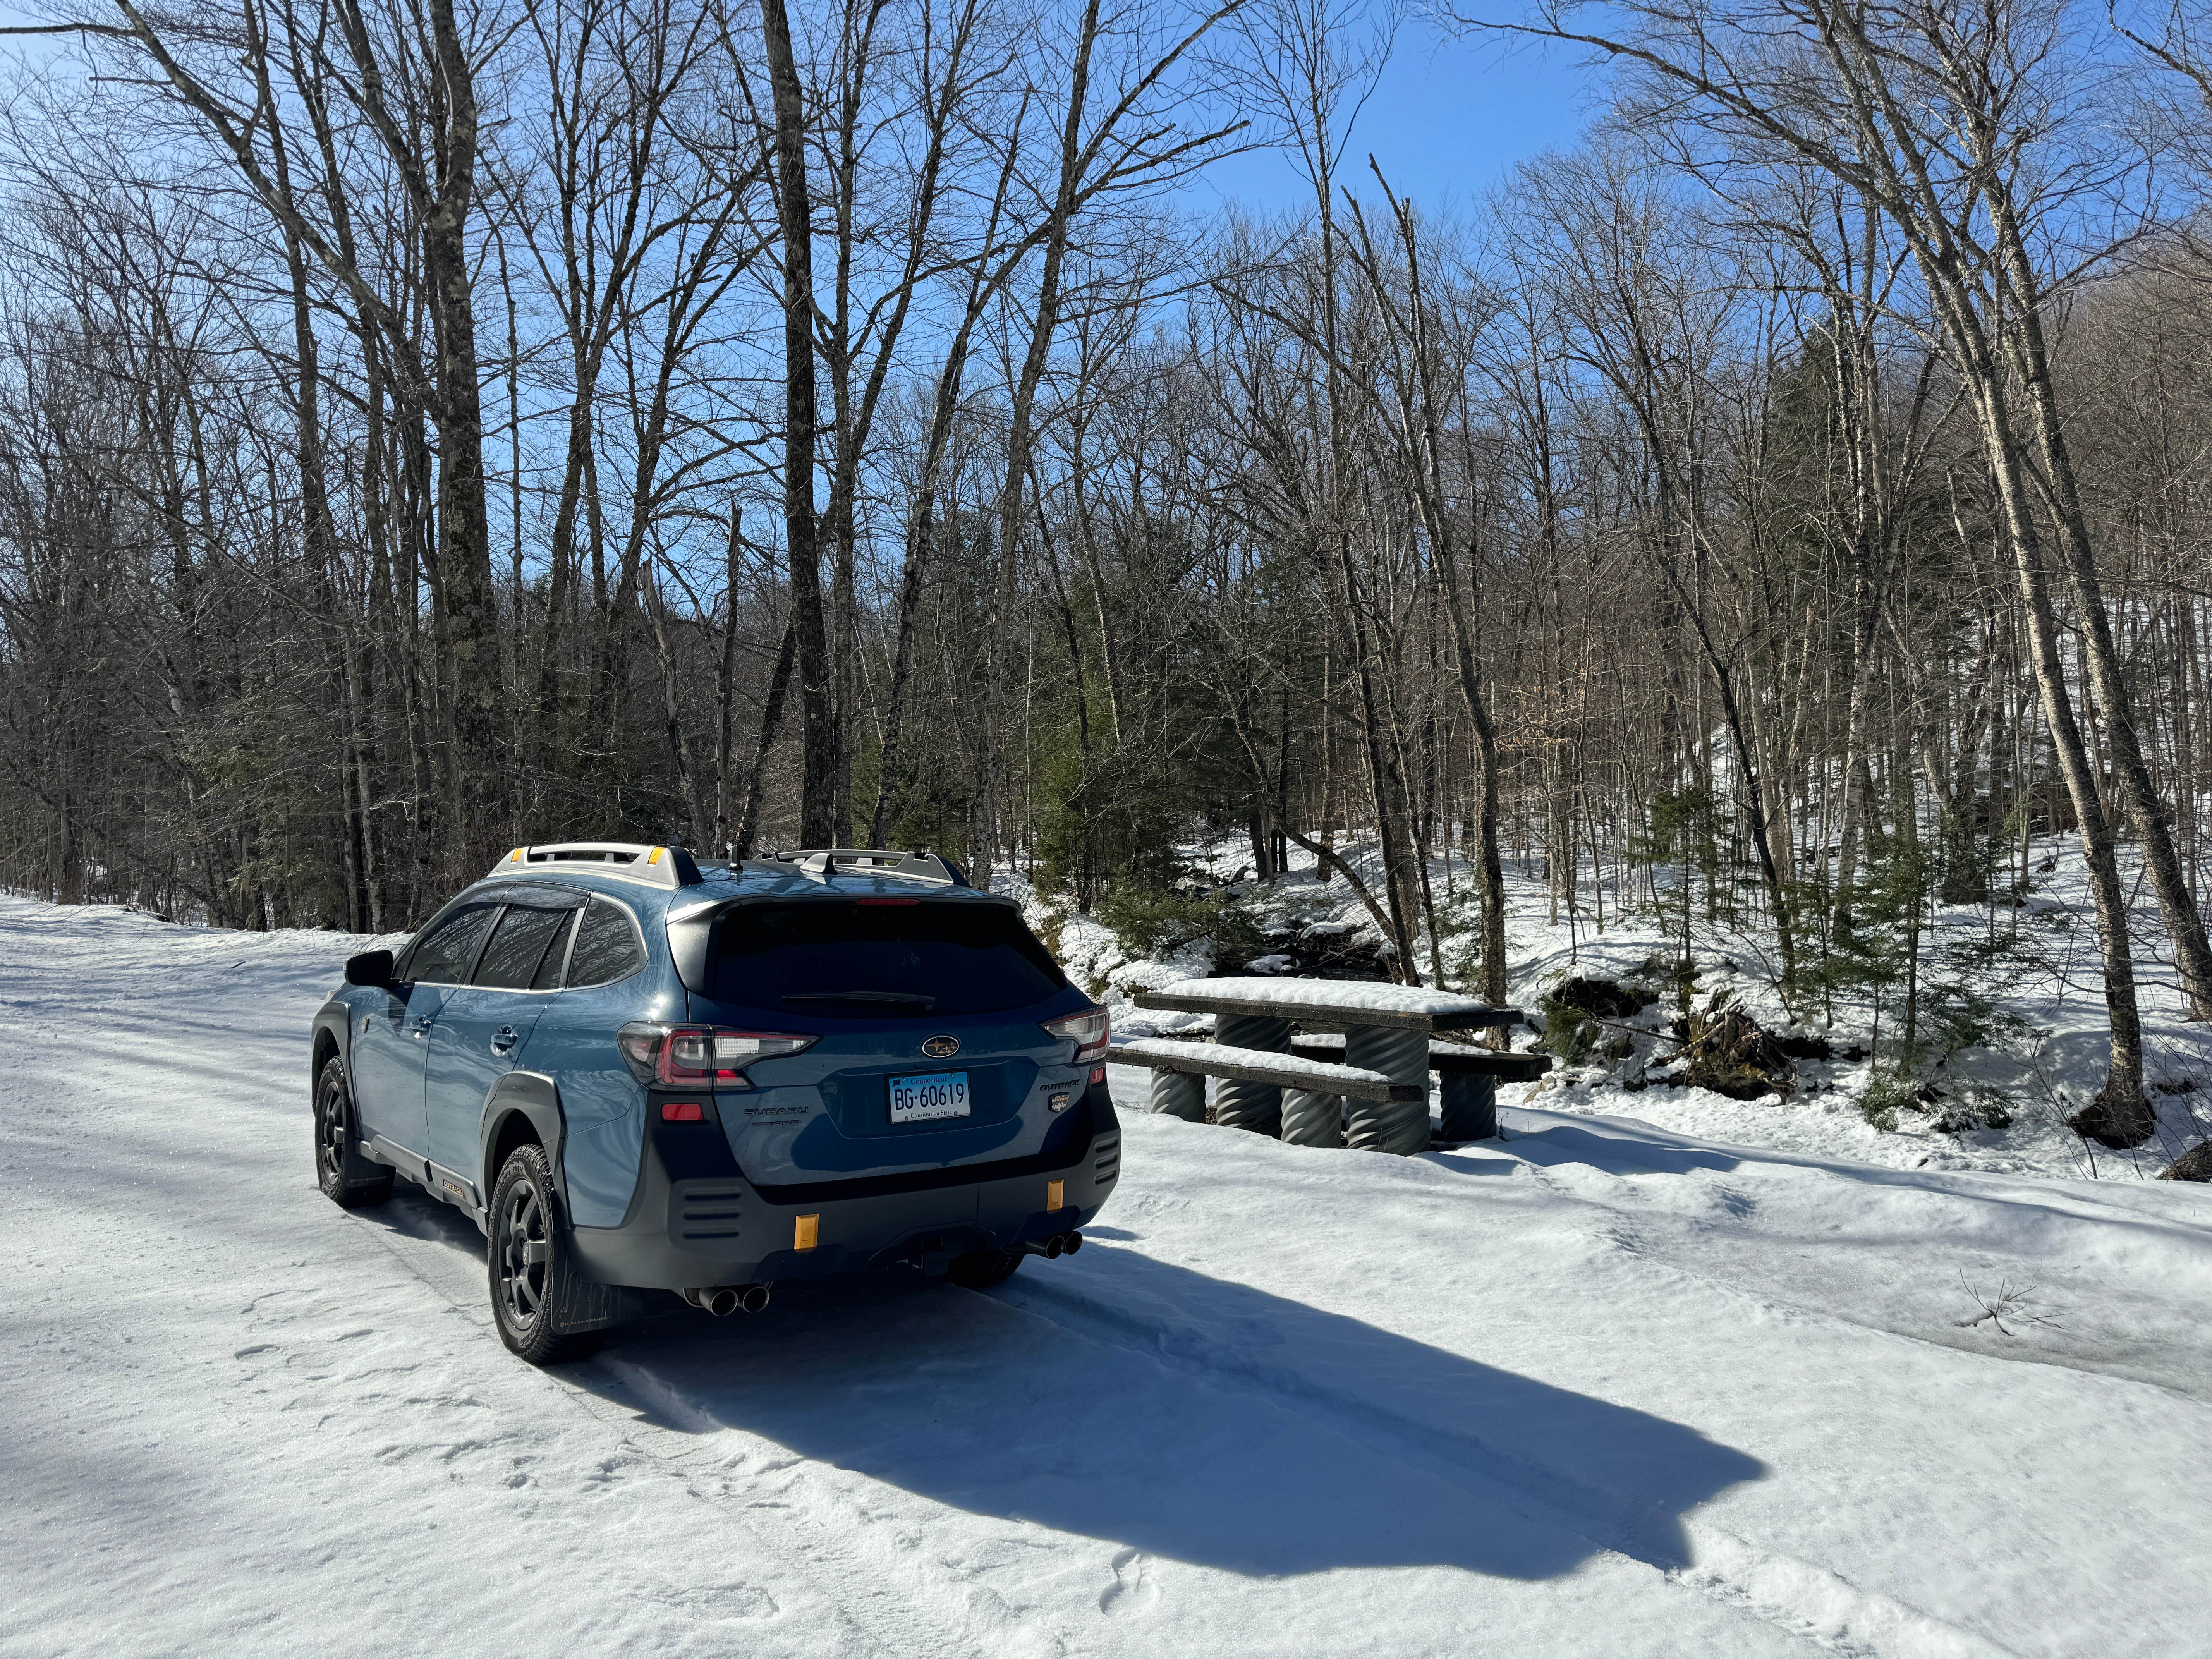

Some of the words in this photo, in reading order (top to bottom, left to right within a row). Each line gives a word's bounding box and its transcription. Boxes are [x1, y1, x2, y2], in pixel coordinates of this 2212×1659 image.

[910, 1076, 947, 1084] Connecticut
[1040, 1079, 1080, 1091] OUTBACK
[744, 1106, 809, 1115] SUBARU
[443, 1180, 462, 1195] OUTBACK
